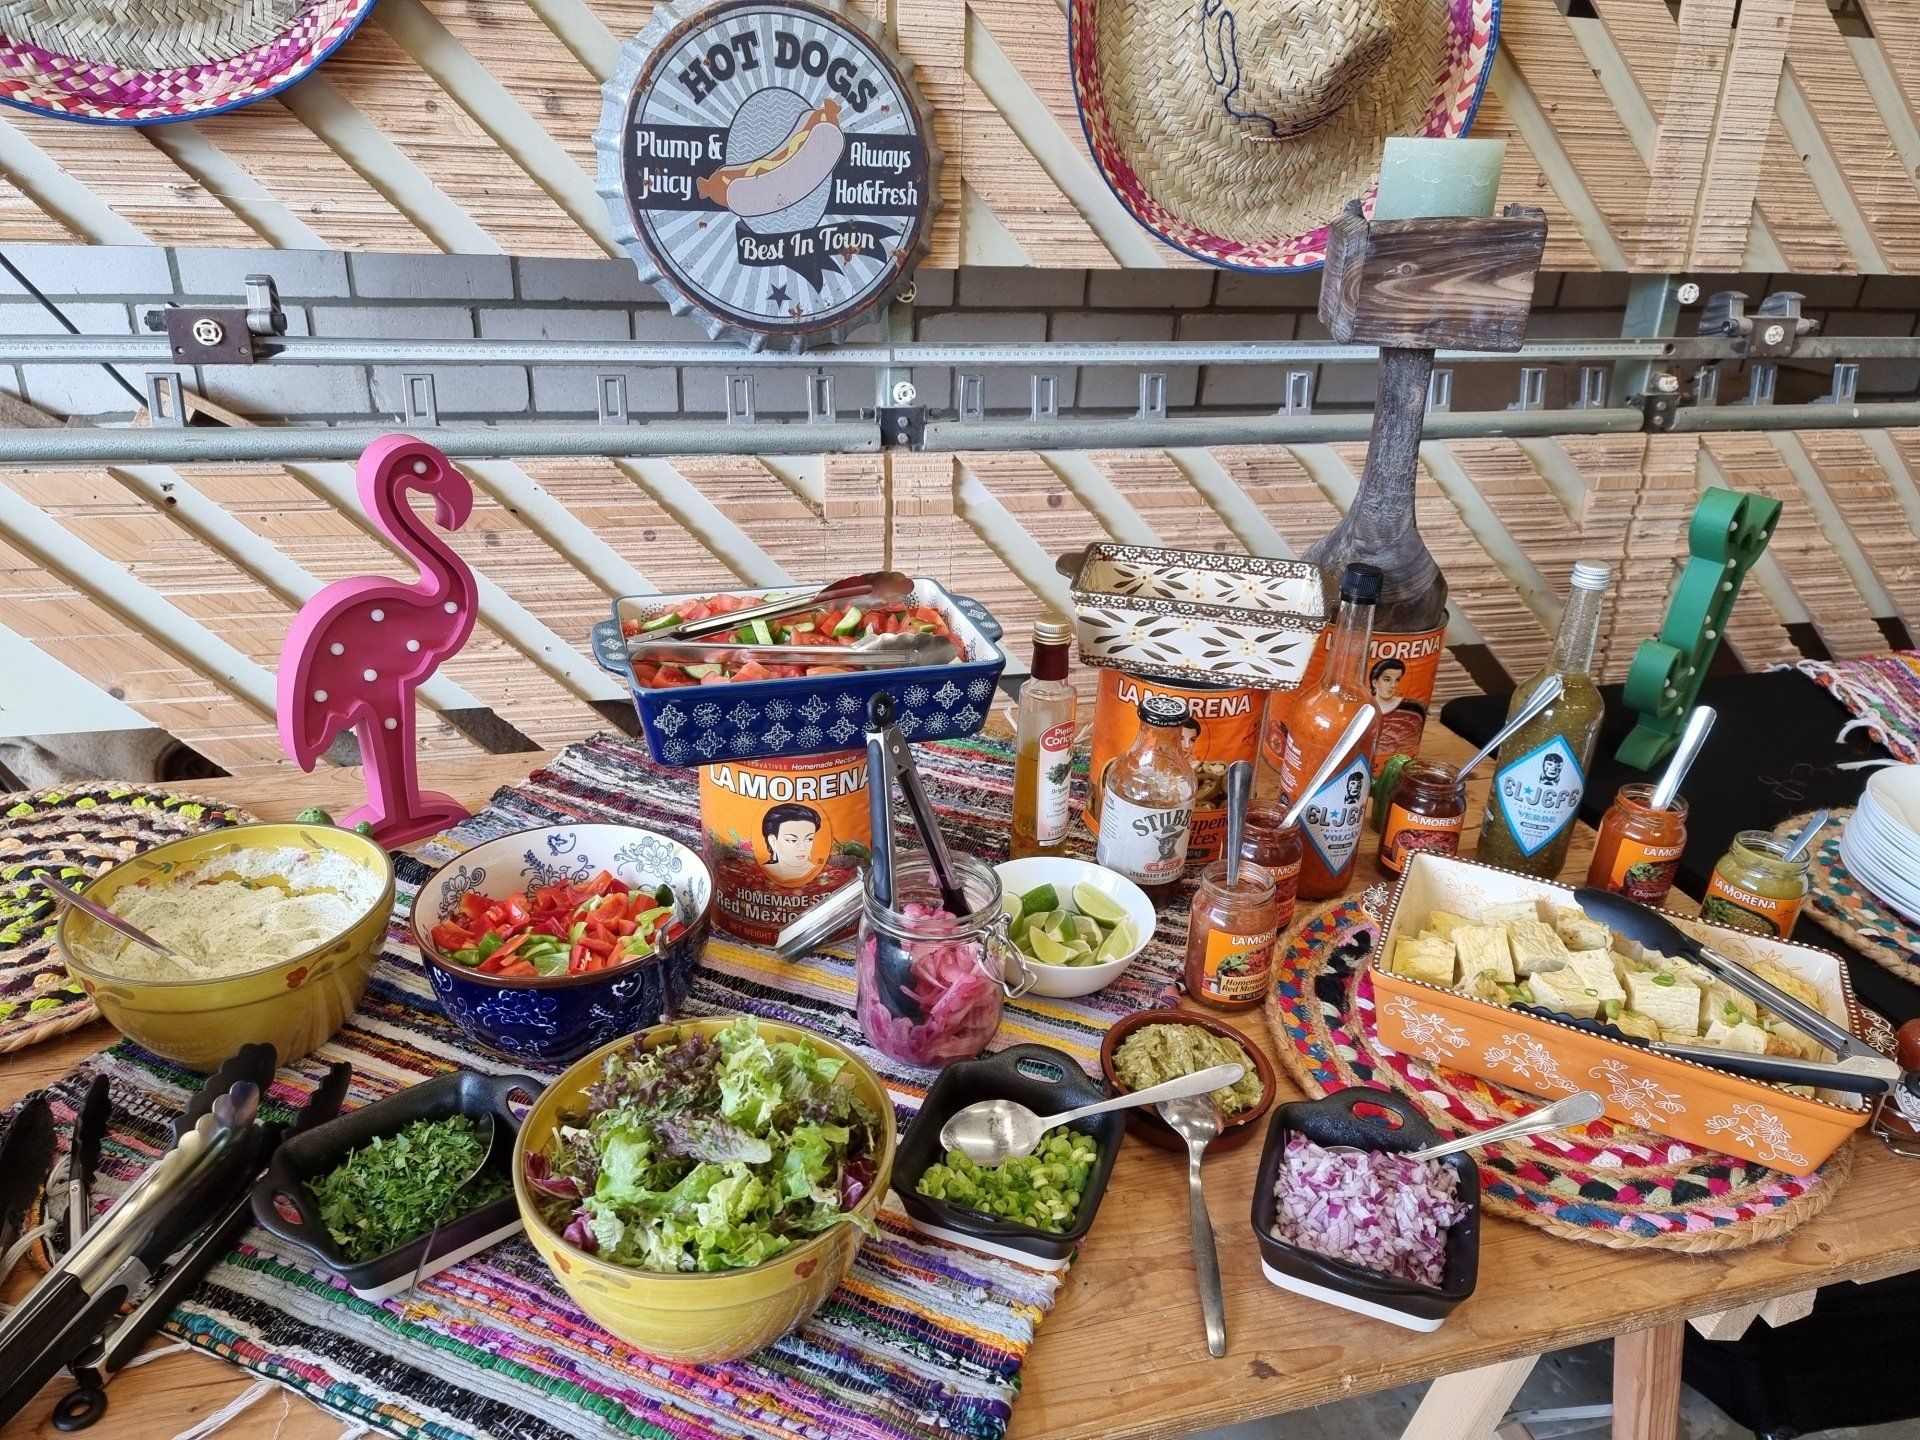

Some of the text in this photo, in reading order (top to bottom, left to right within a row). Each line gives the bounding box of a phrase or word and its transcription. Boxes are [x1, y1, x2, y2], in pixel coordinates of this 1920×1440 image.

[678, 30, 878, 114] HOT DOGS
[636, 131, 723, 165] Plump &
[850, 141, 911, 174] Always
[638, 168, 692, 201] Juicy
[739, 226, 875, 260] Best In Town
[1118, 679, 1139, 707] LA
[792, 760, 833, 771] Homemade
[709, 764, 737, 794] LA
[1408, 812, 1419, 824] LA
[1643, 847, 1657, 857] LA
[716, 889, 740, 914] Red
[737, 887, 831, 907] HOMEMADE ST
[1714, 877, 1777, 910] LA MORENA
[743, 926, 773, 939] WEIGHT
[1231, 936, 1246, 946] LA
[1222, 984, 1239, 993] Red
